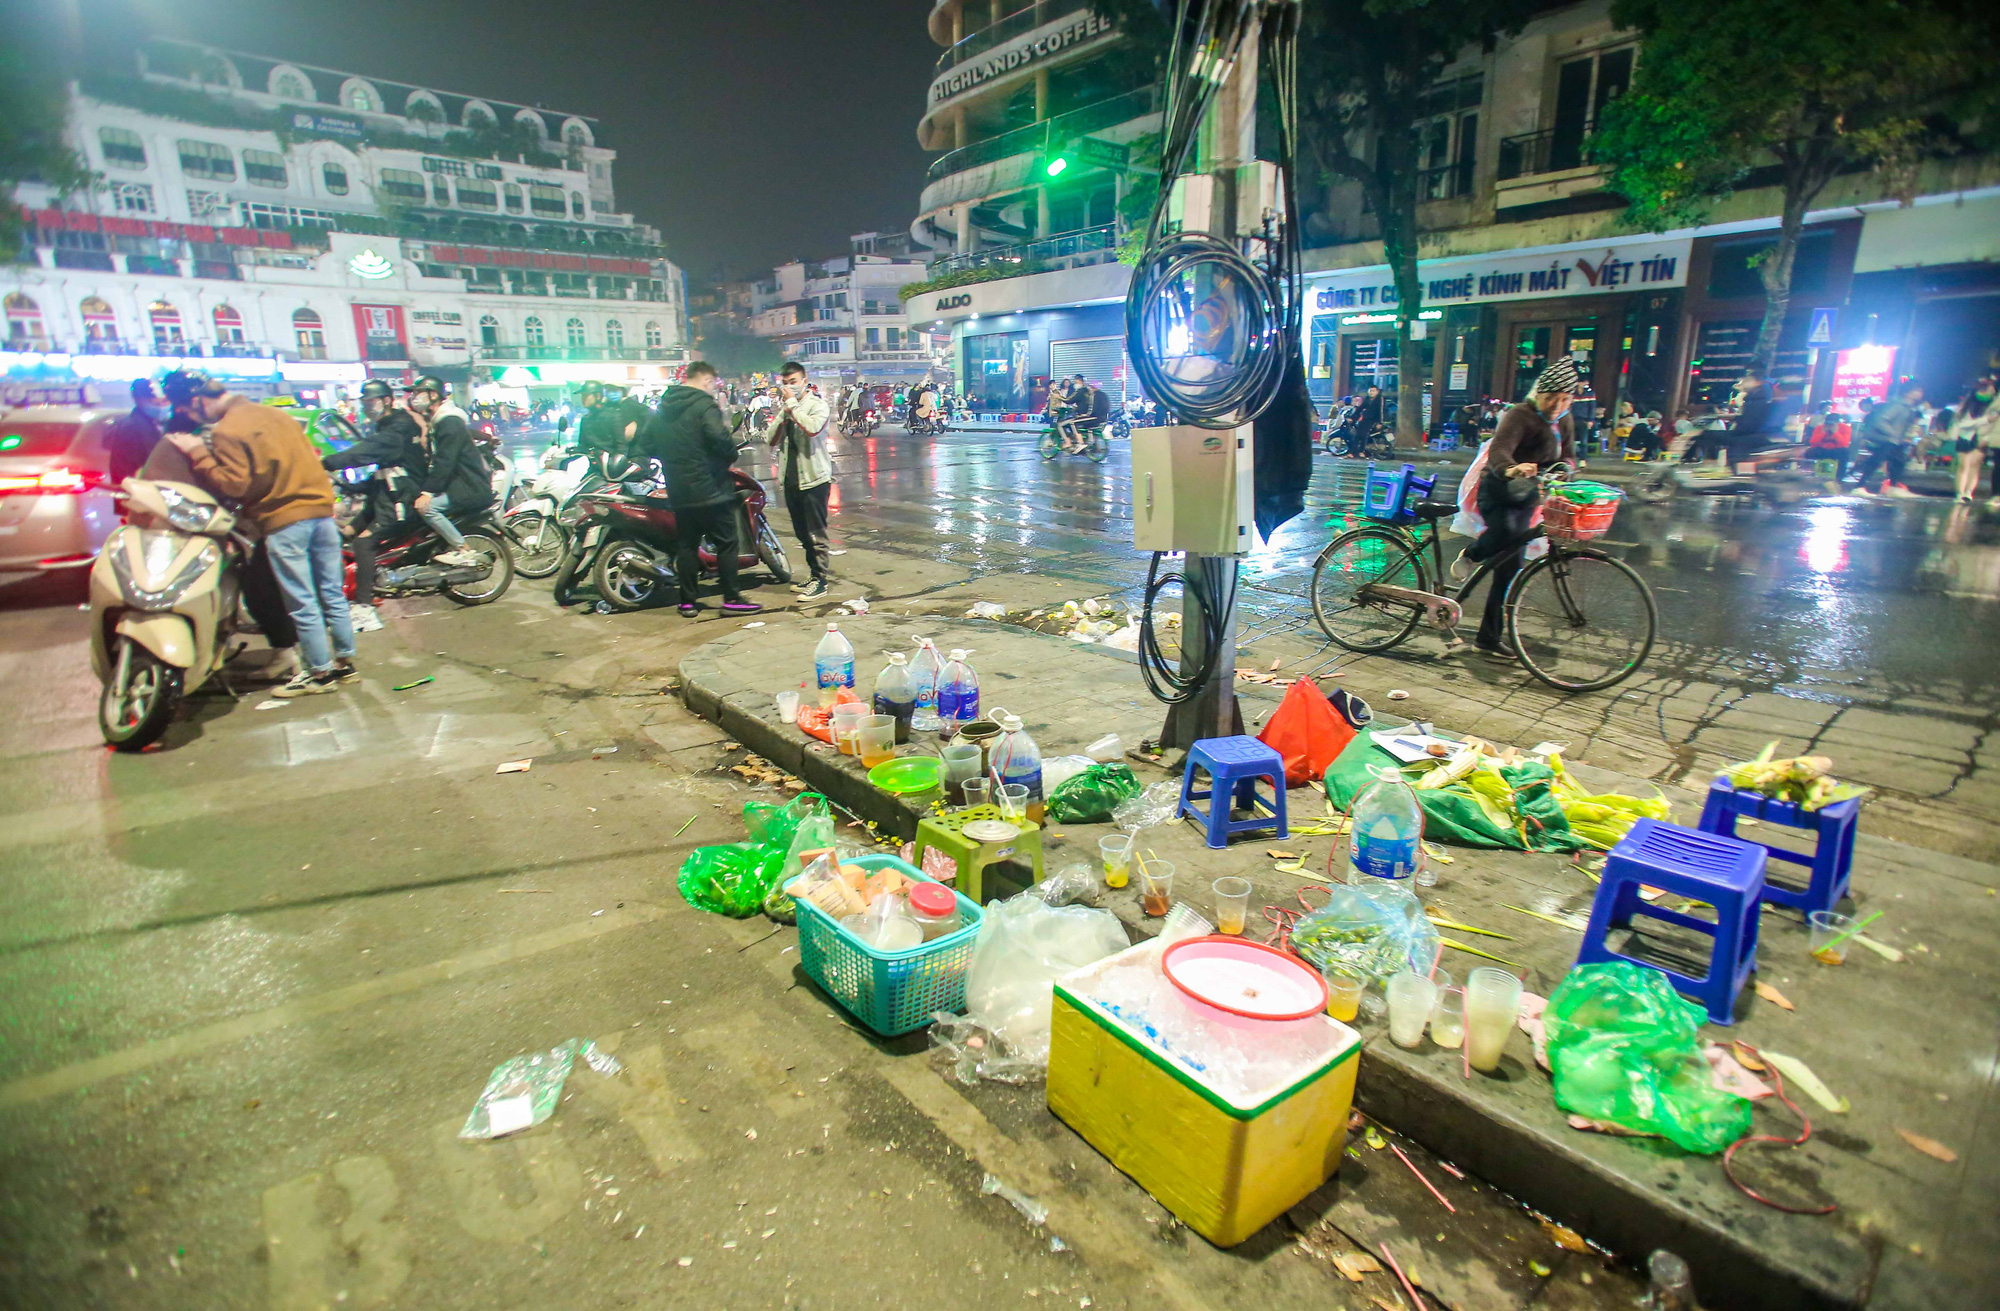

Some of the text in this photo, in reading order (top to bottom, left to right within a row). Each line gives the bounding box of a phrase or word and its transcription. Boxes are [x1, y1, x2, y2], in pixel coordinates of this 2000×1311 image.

[932, 45, 1031, 101] HIGHLANDS
[936, 293, 972, 311] ALDO
[1316, 286, 1356, 309] CÔNG
[1360, 286, 1378, 305] TY
[1428, 272, 1473, 302] NGHỆ
[1479, 270, 1524, 297] KÍNH
[1528, 260, 1572, 292] MẮT
[1576, 249, 1634, 290] VIỆT
[1641, 254, 1677, 282] TÍN
